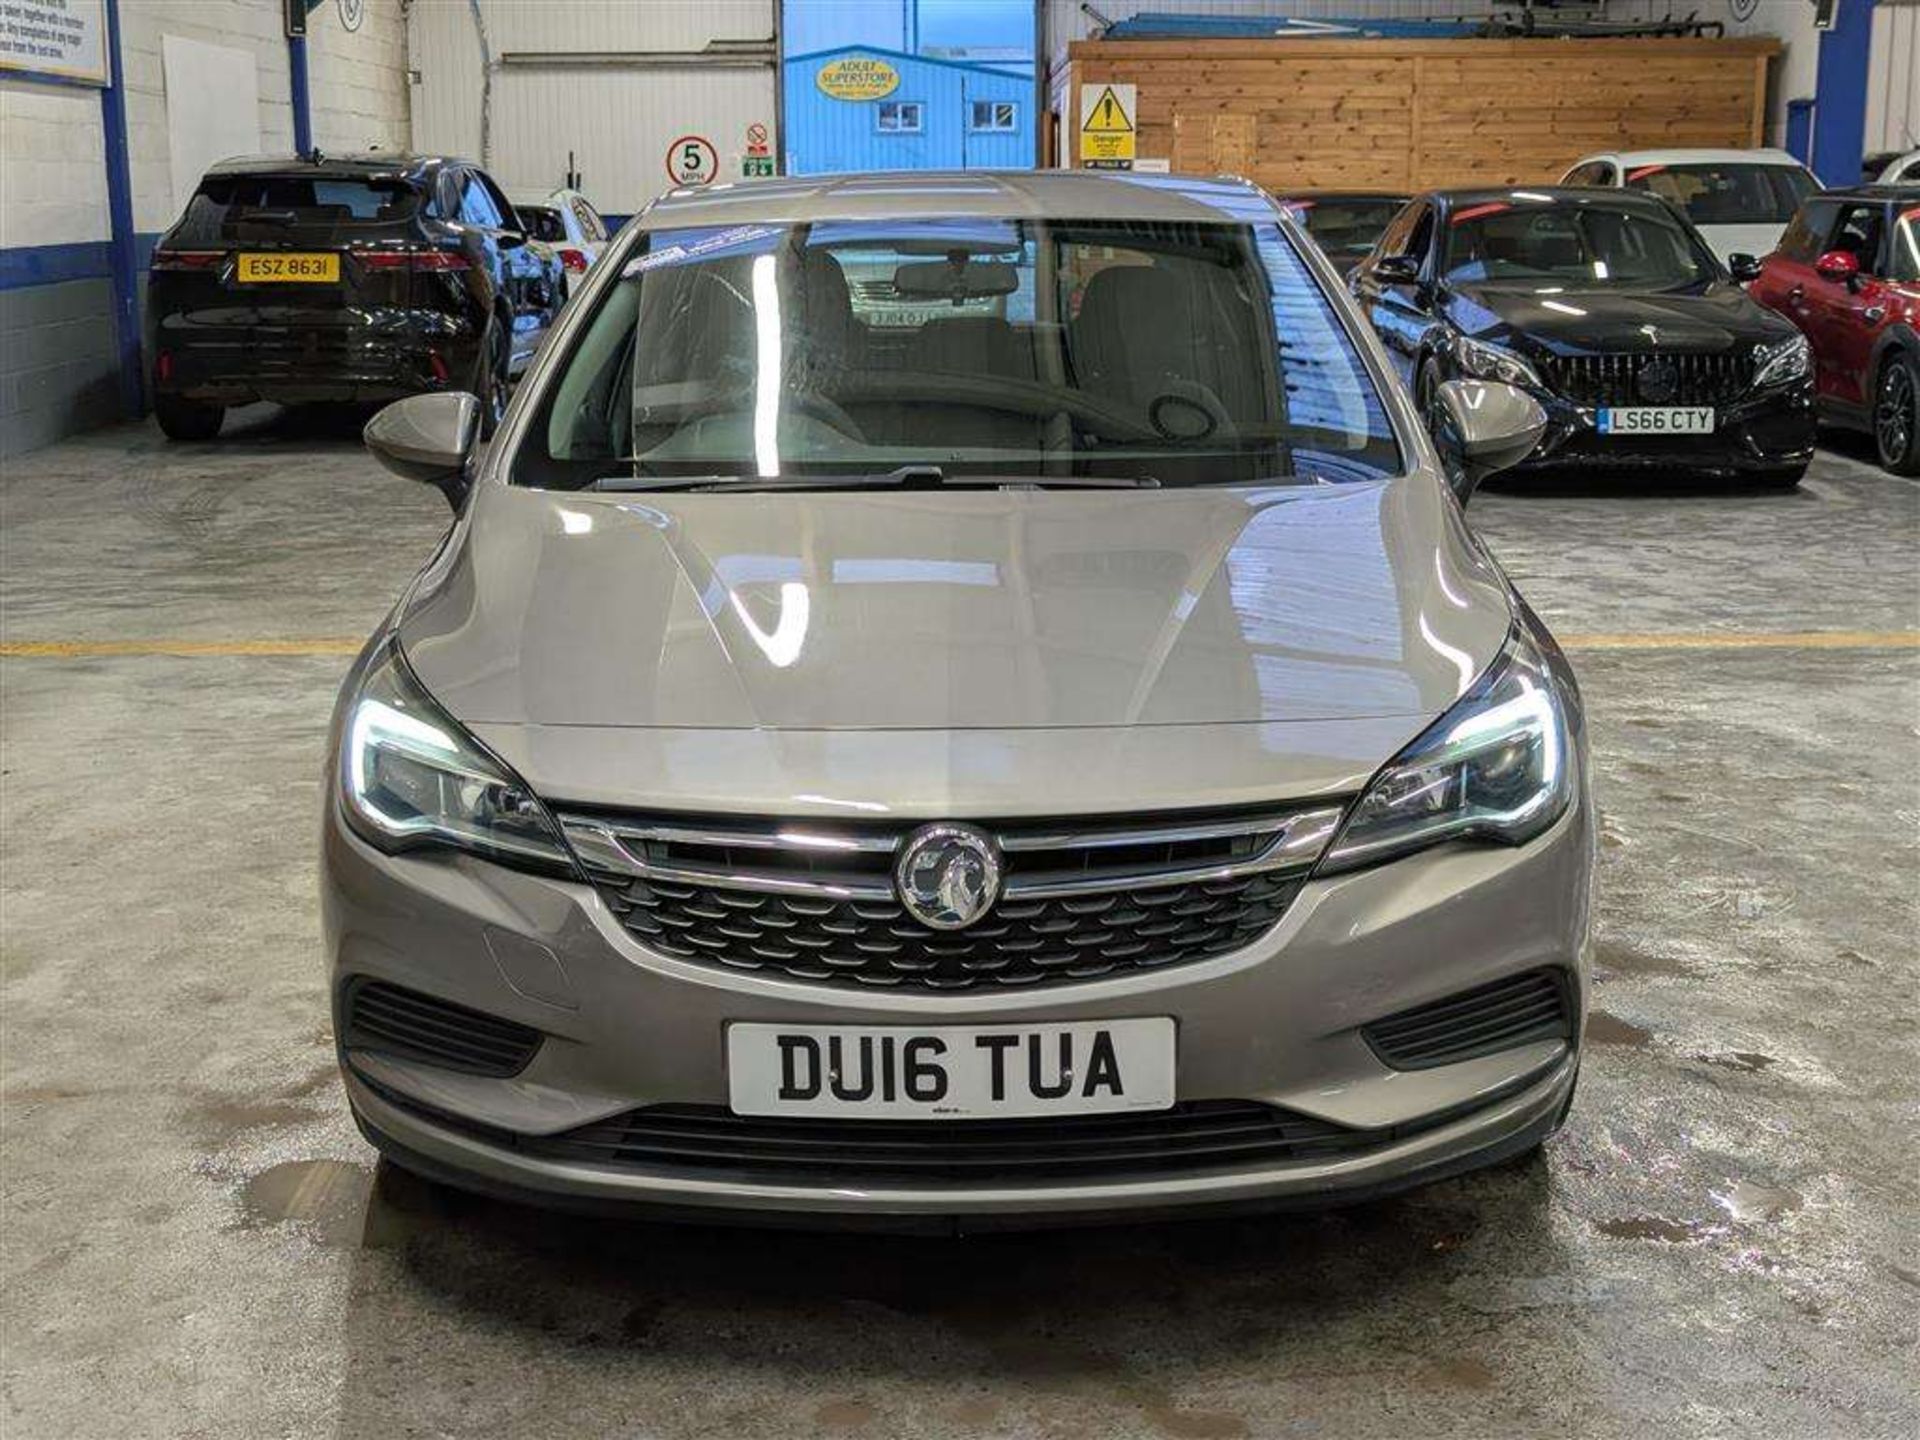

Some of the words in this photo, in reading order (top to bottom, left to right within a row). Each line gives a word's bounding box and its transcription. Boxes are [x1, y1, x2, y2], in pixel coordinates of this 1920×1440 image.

[839, 61, 876, 71] ADULT
[822, 72, 893, 83] SUPERSTORE
[1092, 135, 1123, 143] Danger
[684, 144, 701, 170] 5
[250, 259, 283, 275] ESZ
[288, 259, 327, 275] 8631
[1613, 411, 1665, 430] LS66
[1671, 411, 1709, 430] CTY
[776, 1034, 948, 1103] DU16
[975, 1030, 1124, 1102] TUA
